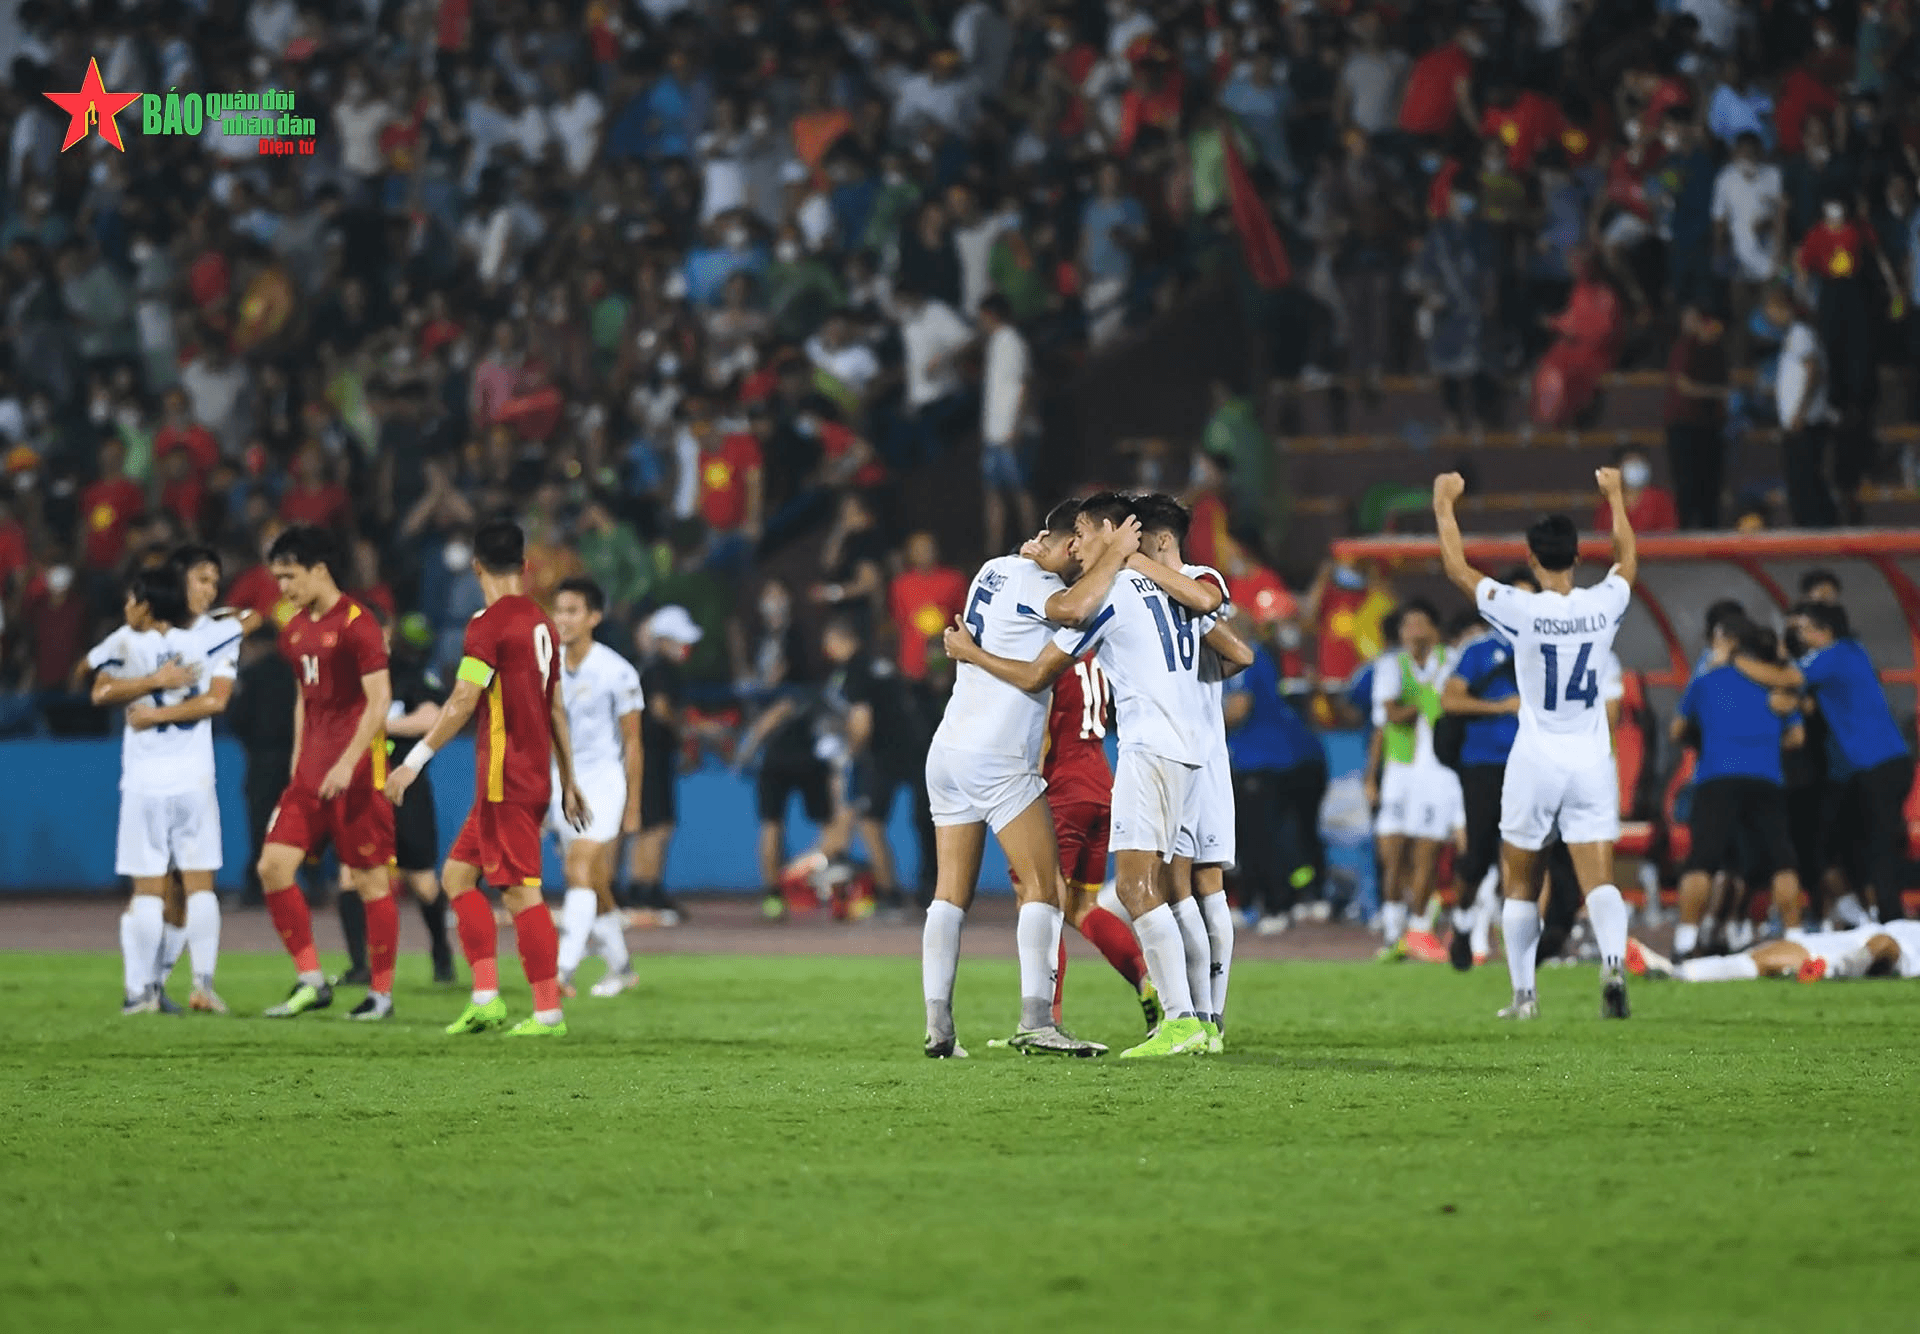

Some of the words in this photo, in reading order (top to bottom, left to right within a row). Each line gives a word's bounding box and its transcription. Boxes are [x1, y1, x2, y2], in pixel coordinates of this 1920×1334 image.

[966, 586, 994, 648] 5
[1143, 595, 1194, 672] 18
[533, 622, 553, 698] 9
[1074, 657, 1110, 739] 10
[1540, 642, 1599, 711] 14
